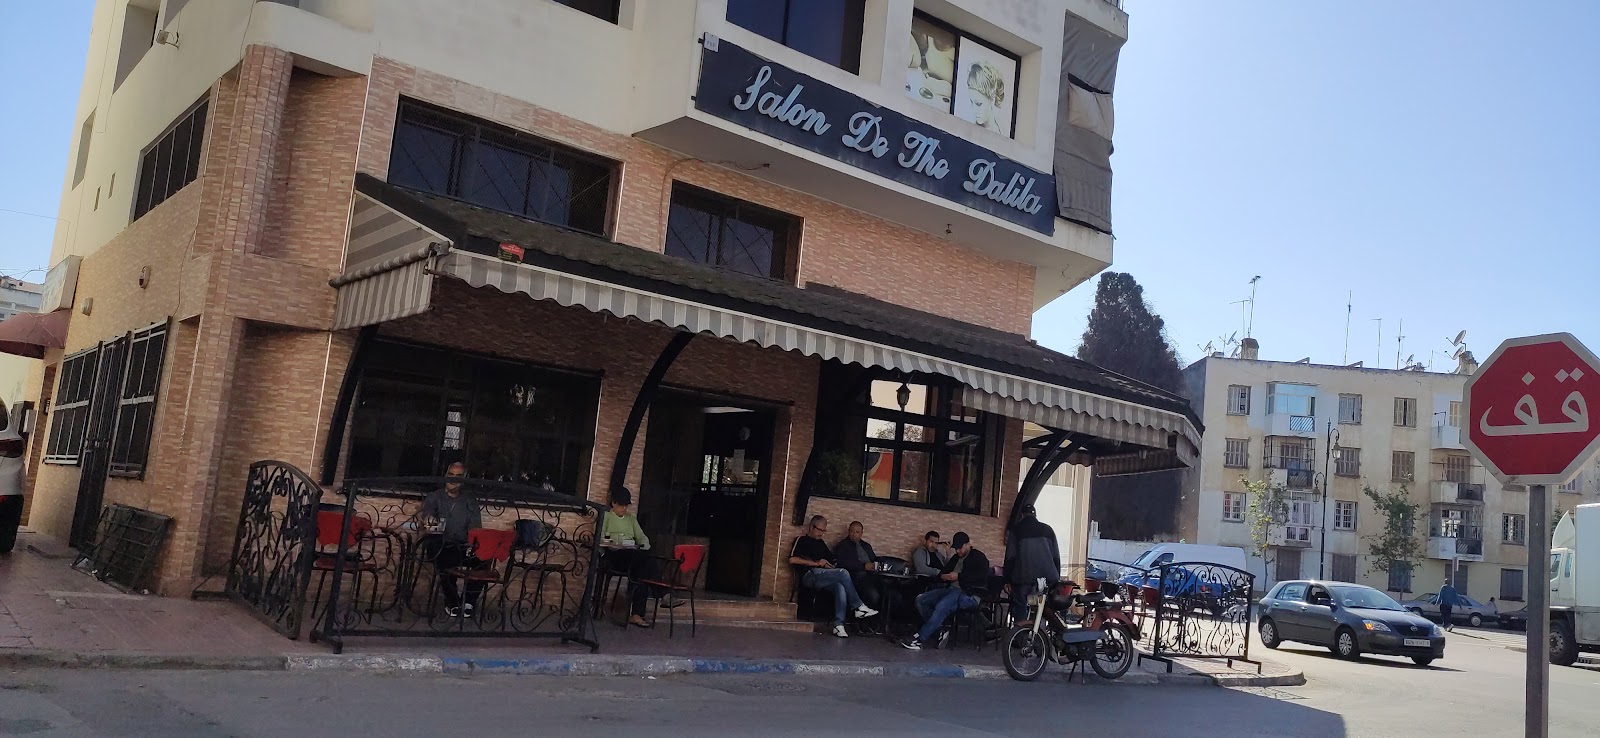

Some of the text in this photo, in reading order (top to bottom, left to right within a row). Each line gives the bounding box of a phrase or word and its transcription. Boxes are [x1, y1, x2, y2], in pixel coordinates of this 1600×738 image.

[733, 65, 1043, 216] Salon De The Dalila
[1479, 367, 1590, 437] قف
